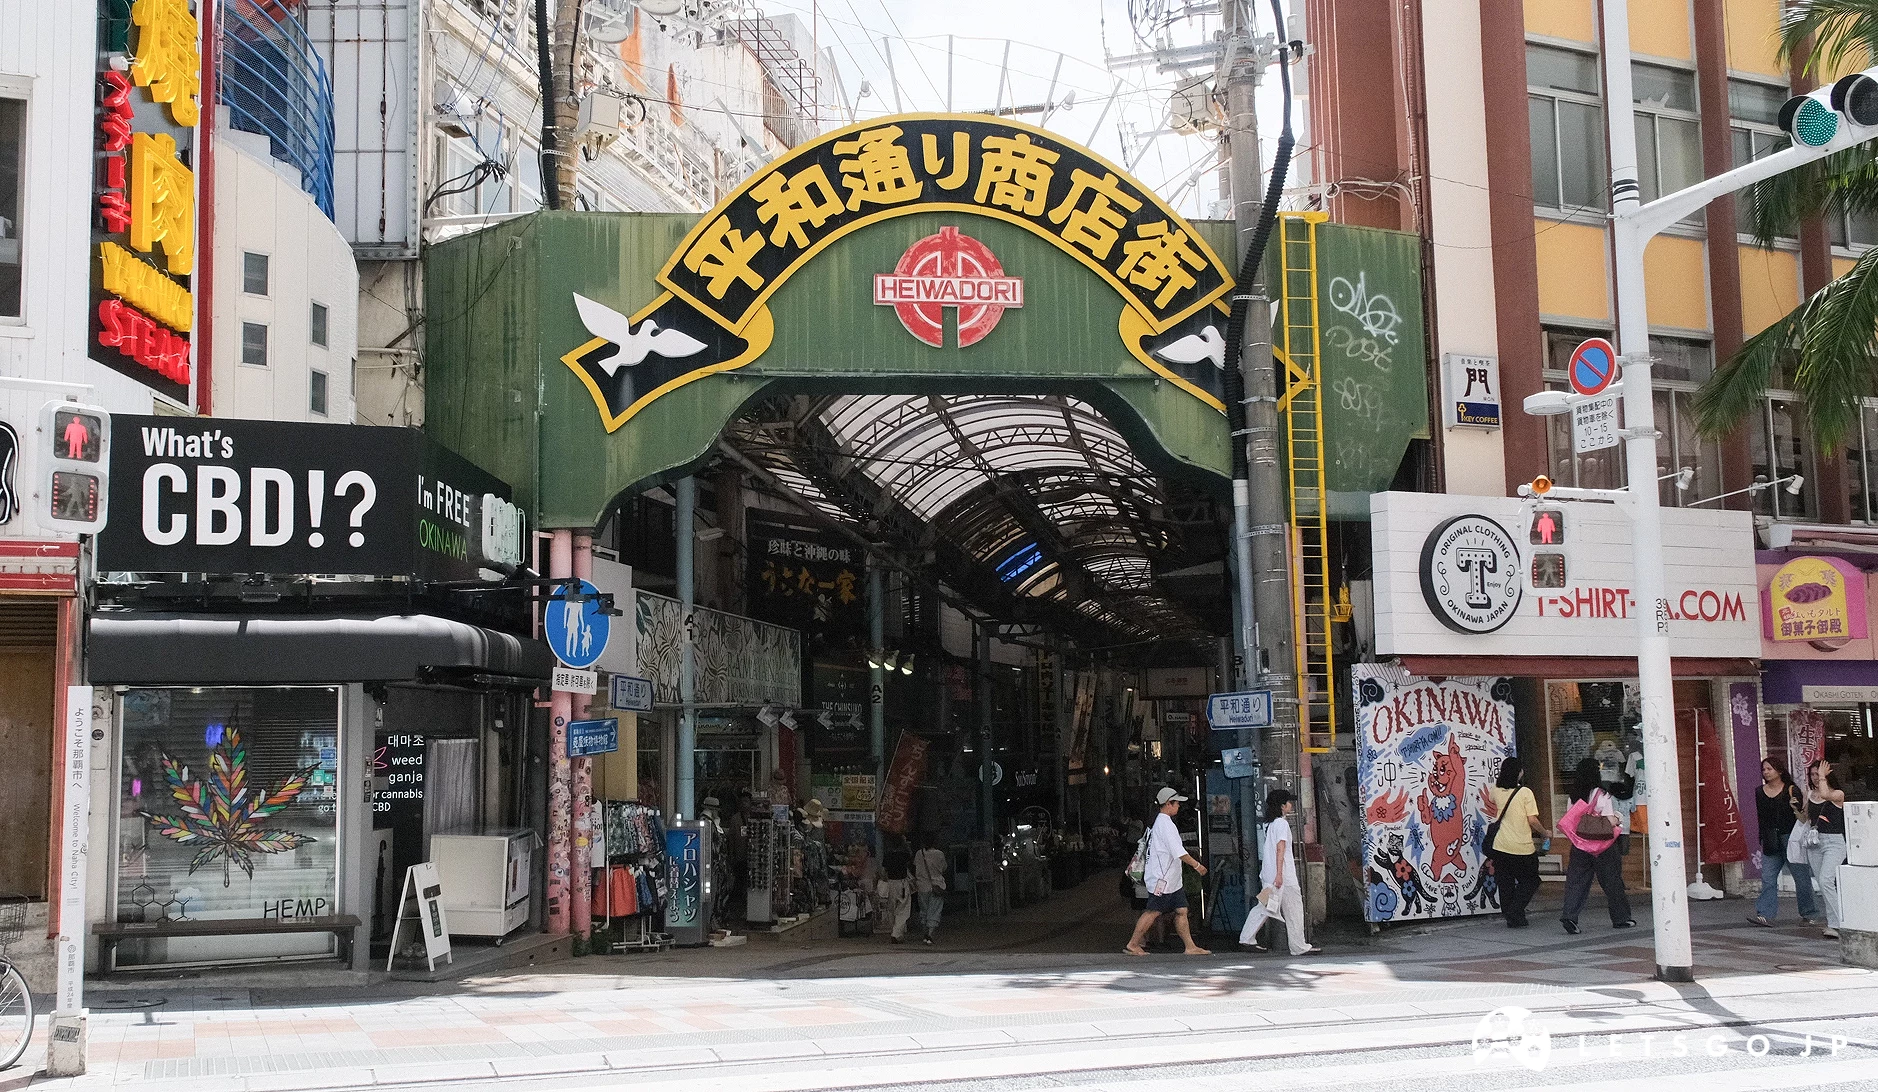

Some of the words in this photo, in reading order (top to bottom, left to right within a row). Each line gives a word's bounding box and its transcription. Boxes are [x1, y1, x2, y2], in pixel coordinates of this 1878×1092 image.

[693, 125, 1208, 309] 平和通り商店街
[881, 276, 1019, 300] HEIWADORI
[98, 300, 191, 384] STEAK
[1463, 367, 1491, 397] 門
[1475, 416, 1498, 424] COFFEE
[142, 427, 234, 459] What's
[1580, 433, 1614, 449] ここから
[142, 463, 377, 549] CBD!?
[418, 474, 433, 510] I'm
[437, 480, 470, 527] FREE
[419, 518, 468, 562] OKINAWA
[768, 540, 851, 563] 珍味と沖縄の味
[1440, 525, 1472, 556] ORIGINAL
[1474, 525, 1511, 559] CLOTHING
[1486, 581, 1501, 589] Enjoy
[1447, 599, 1484, 624] OKINAWA
[1486, 600, 1509, 623] JAPAN
[1781, 618, 1843, 637] 御菓子御殿
[1219, 697, 1262, 714] 平和通り
[1813, 691, 1839, 699] OKASHI
[1840, 690, 1863, 699] GOTEN
[1372, 686, 1507, 746] OKINAWA
[72, 707, 84, 789] ようこそ那覇市へ
[391, 754, 423, 766] weed
[388, 770, 423, 785] ganja
[1376, 758, 1397, 788] 沖
[381, 789, 423, 799] cannabis
[372, 802, 391, 812] CBD
[72, 803, 80, 838] Welcome
[71, 852, 79, 869] Naha
[669, 856, 681, 923] に着替えよう
[683, 832, 697, 923] アロハシャツ
[1424, 881, 1438, 895] HAVE
[264, 898, 326, 919] HEMP
